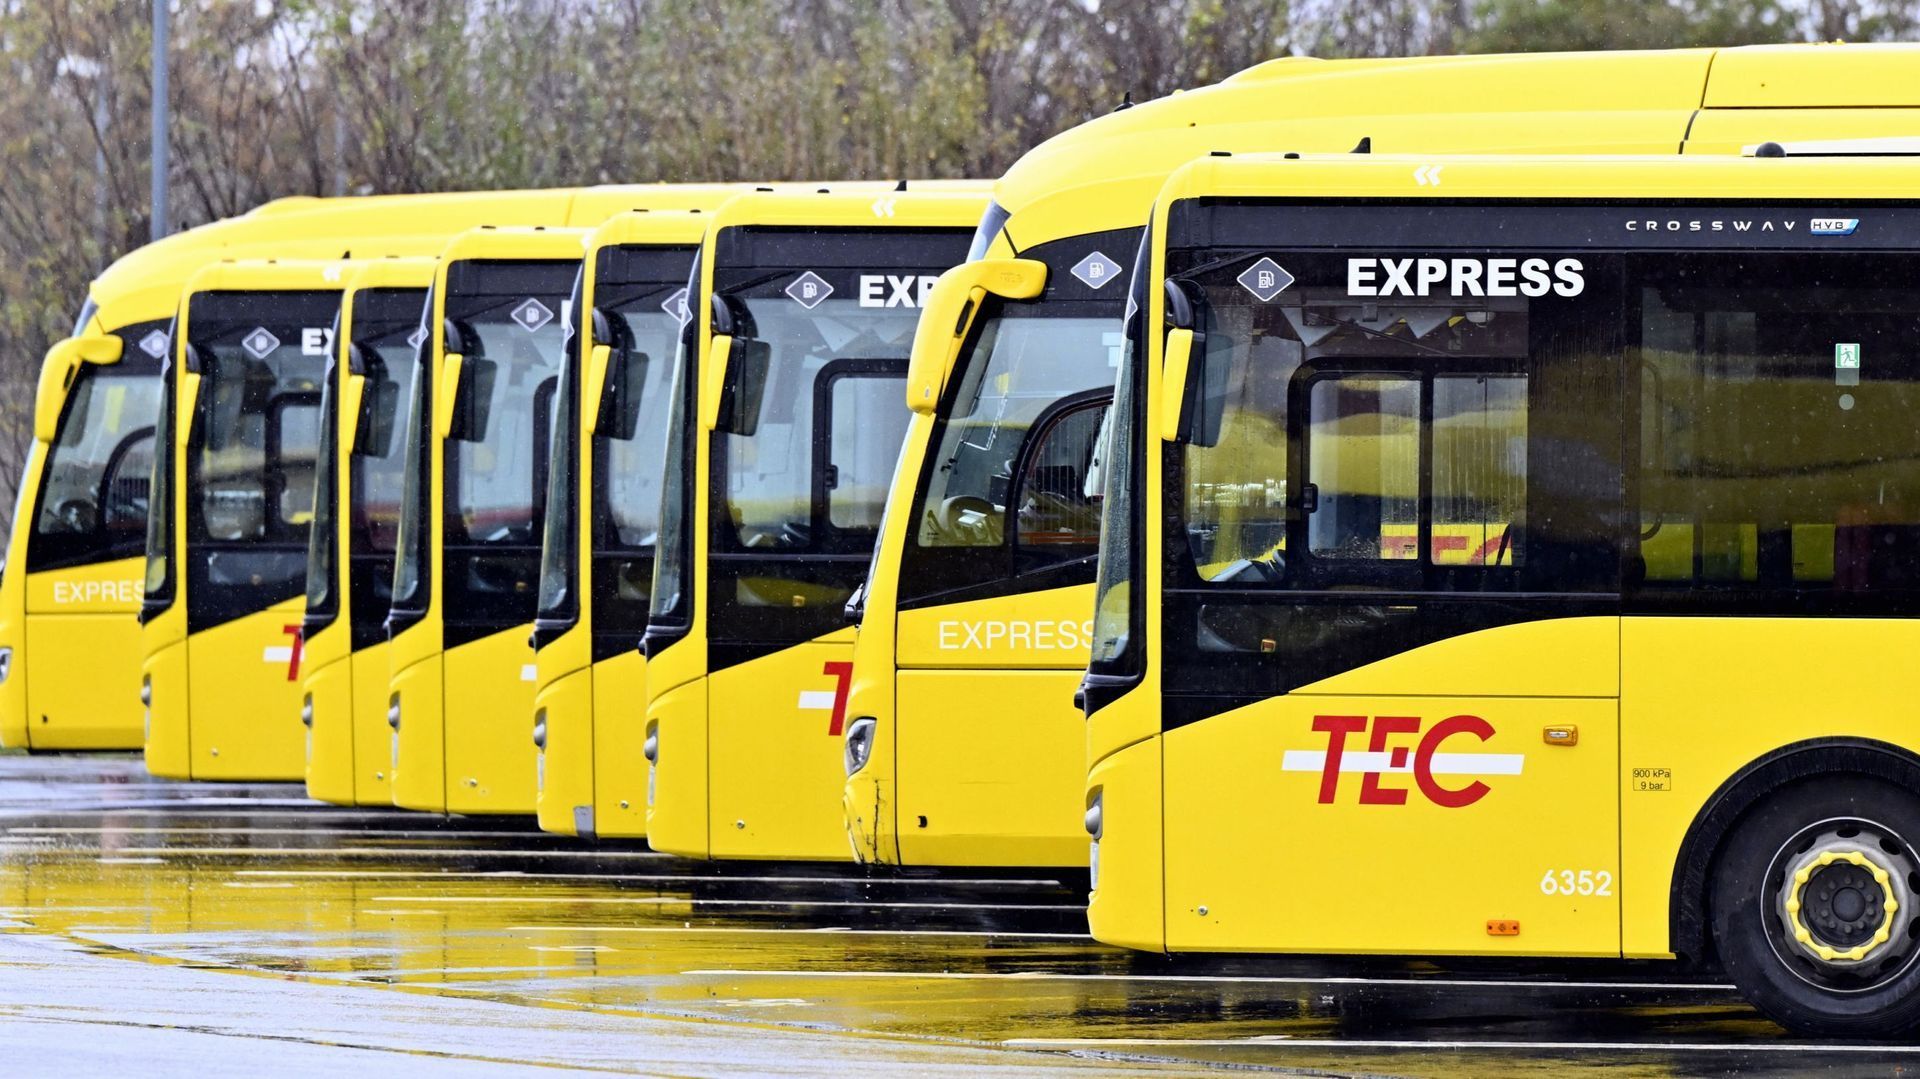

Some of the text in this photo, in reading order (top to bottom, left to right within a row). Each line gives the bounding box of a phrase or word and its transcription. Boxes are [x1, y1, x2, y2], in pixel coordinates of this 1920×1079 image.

[1347, 258, 1585, 298] EXPRESS
[1311, 714, 1497, 809] TEC
[1633, 769, 1671, 778] 900 kPa
[1640, 781, 1664, 790] 9 bar
[1540, 869, 1613, 897] 6352
